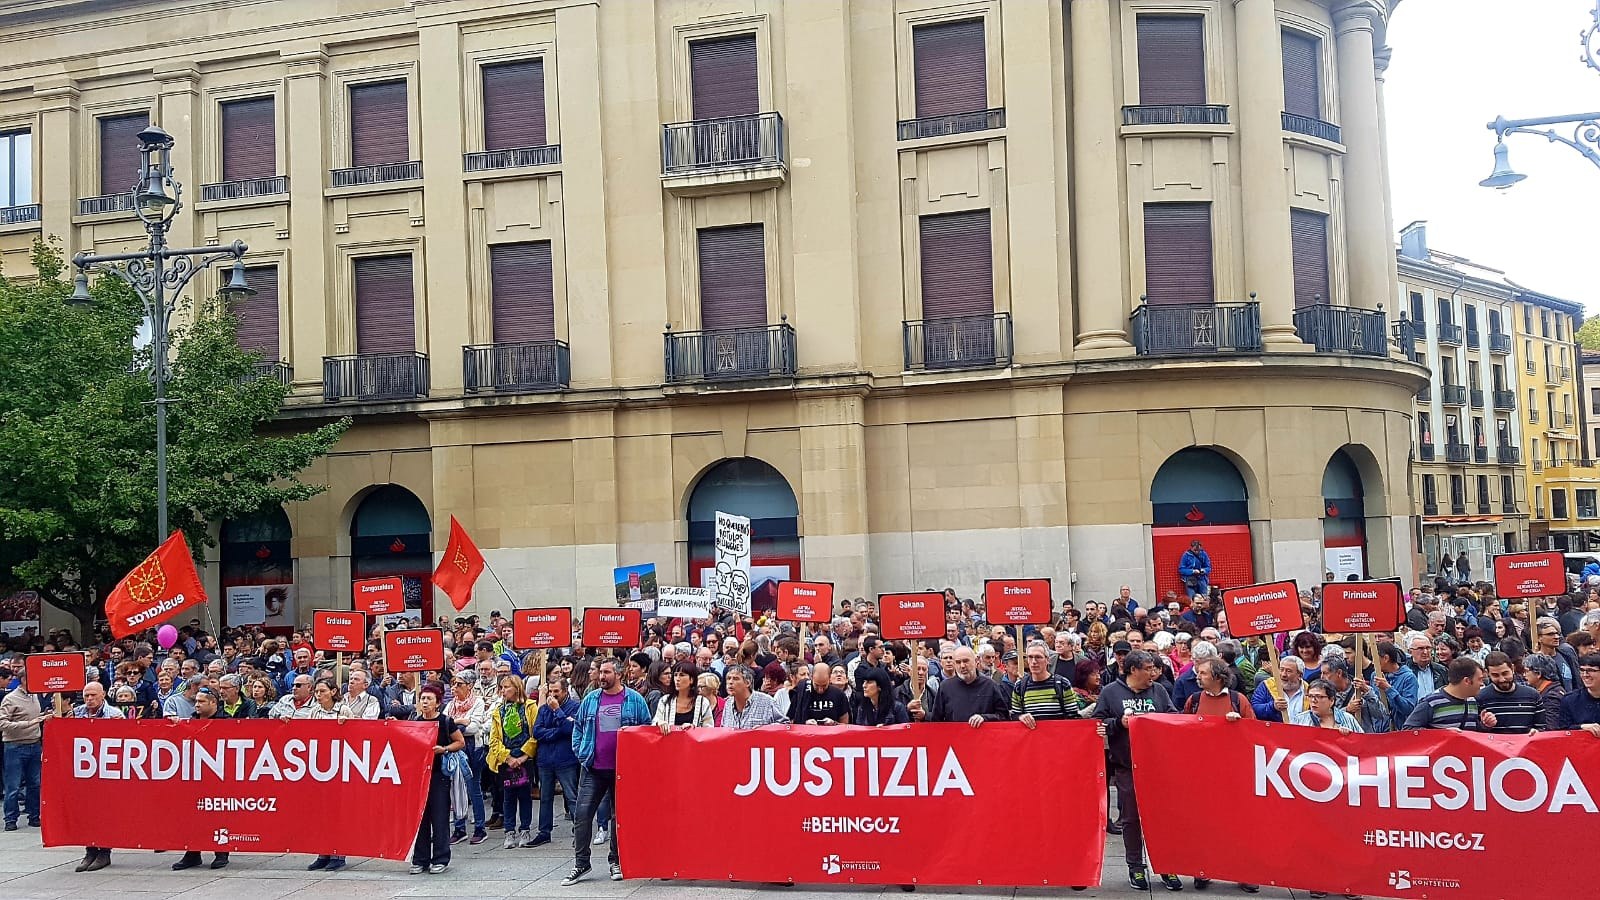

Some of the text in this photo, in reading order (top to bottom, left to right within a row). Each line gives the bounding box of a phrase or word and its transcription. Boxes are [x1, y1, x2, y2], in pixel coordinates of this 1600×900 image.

[1508, 558, 1549, 569] Jurramendi
[1003, 586, 1031, 595] Erribera
[1233, 590, 1288, 605] Aurrepirinioak
[1343, 590, 1378, 599] Pirinioak
[899, 600, 925, 609] Sakana
[73, 737, 402, 785] BERDINTASUNA
[734, 745, 974, 797] JUSTIZIA
[1254, 744, 1599, 813] KOHESIOA
[196, 797, 277, 812] #BEHINGOZ
[802, 816, 900, 834] #BEHINGOZ
[1363, 829, 1485, 852] #BEHINGOZ
[841, 862, 881, 871] KONTSEILUA
[1412, 879, 1461, 889] KONTSEILUA
